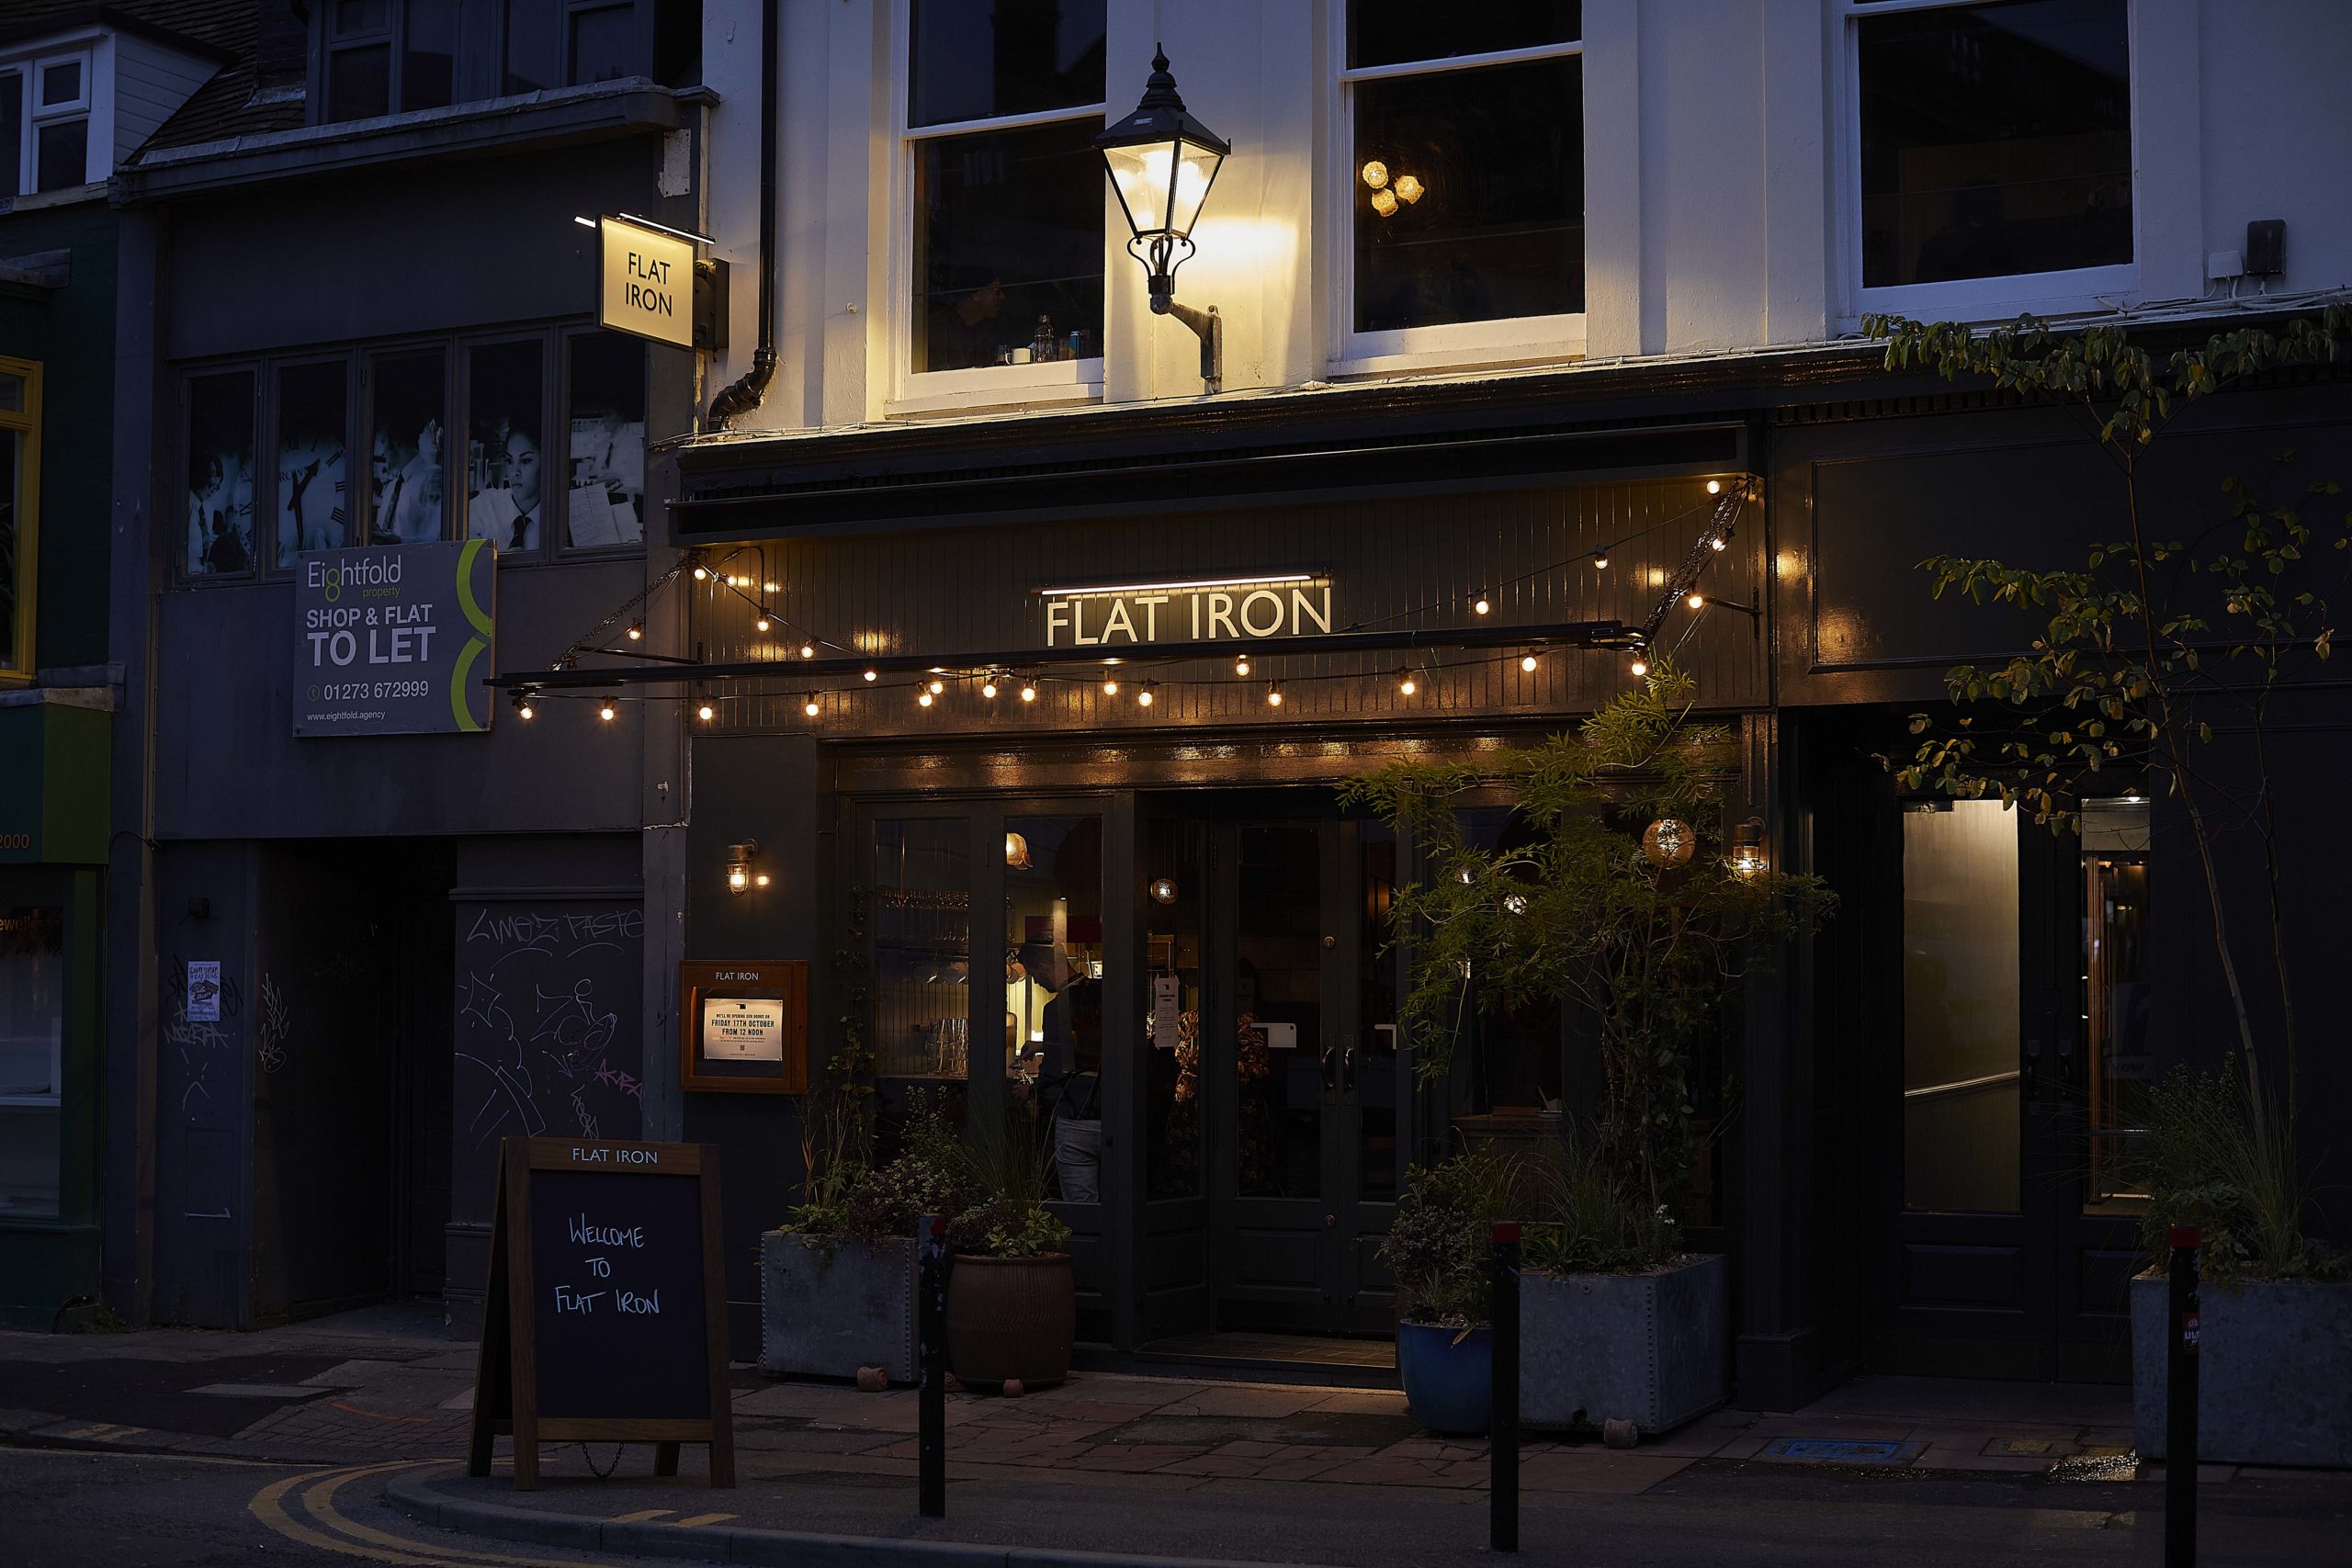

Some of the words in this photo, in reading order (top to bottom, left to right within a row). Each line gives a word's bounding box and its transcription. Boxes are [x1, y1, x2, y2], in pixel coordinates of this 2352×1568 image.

[628, 252, 671, 285] FLAT
[626, 282, 672, 317] IRON
[308, 554, 401, 603] Eightfold
[363, 586, 401, 600] property
[306, 608, 361, 628] SHOP
[365, 607, 379, 626] &
[385, 604, 433, 626] FLAT
[1047, 596, 1169, 646] FLAT
[1192, 588, 1331, 639] IRON
[307, 630, 356, 666] TO
[368, 626, 436, 664] LET
[323, 683, 369, 701] 01273
[373, 680, 429, 697] 672999
[307, 710, 386, 722] www.eightfold.agency
[715, 972, 735, 980] FLAT
[737, 972, 759, 981] IRON
[721, 1028, 738, 1036] FROM
[740, 1028, 746, 1036] 12
[748, 1028, 763, 1036] NOON
[733, 1020, 747, 1028] 17TH
[572, 1148, 610, 1162] FLAT
[616, 1150, 658, 1165] IRON
[584, 1257, 611, 1278] TO
[554, 1285, 607, 1315] FLAT
[616, 1289, 661, 1314] IRON
